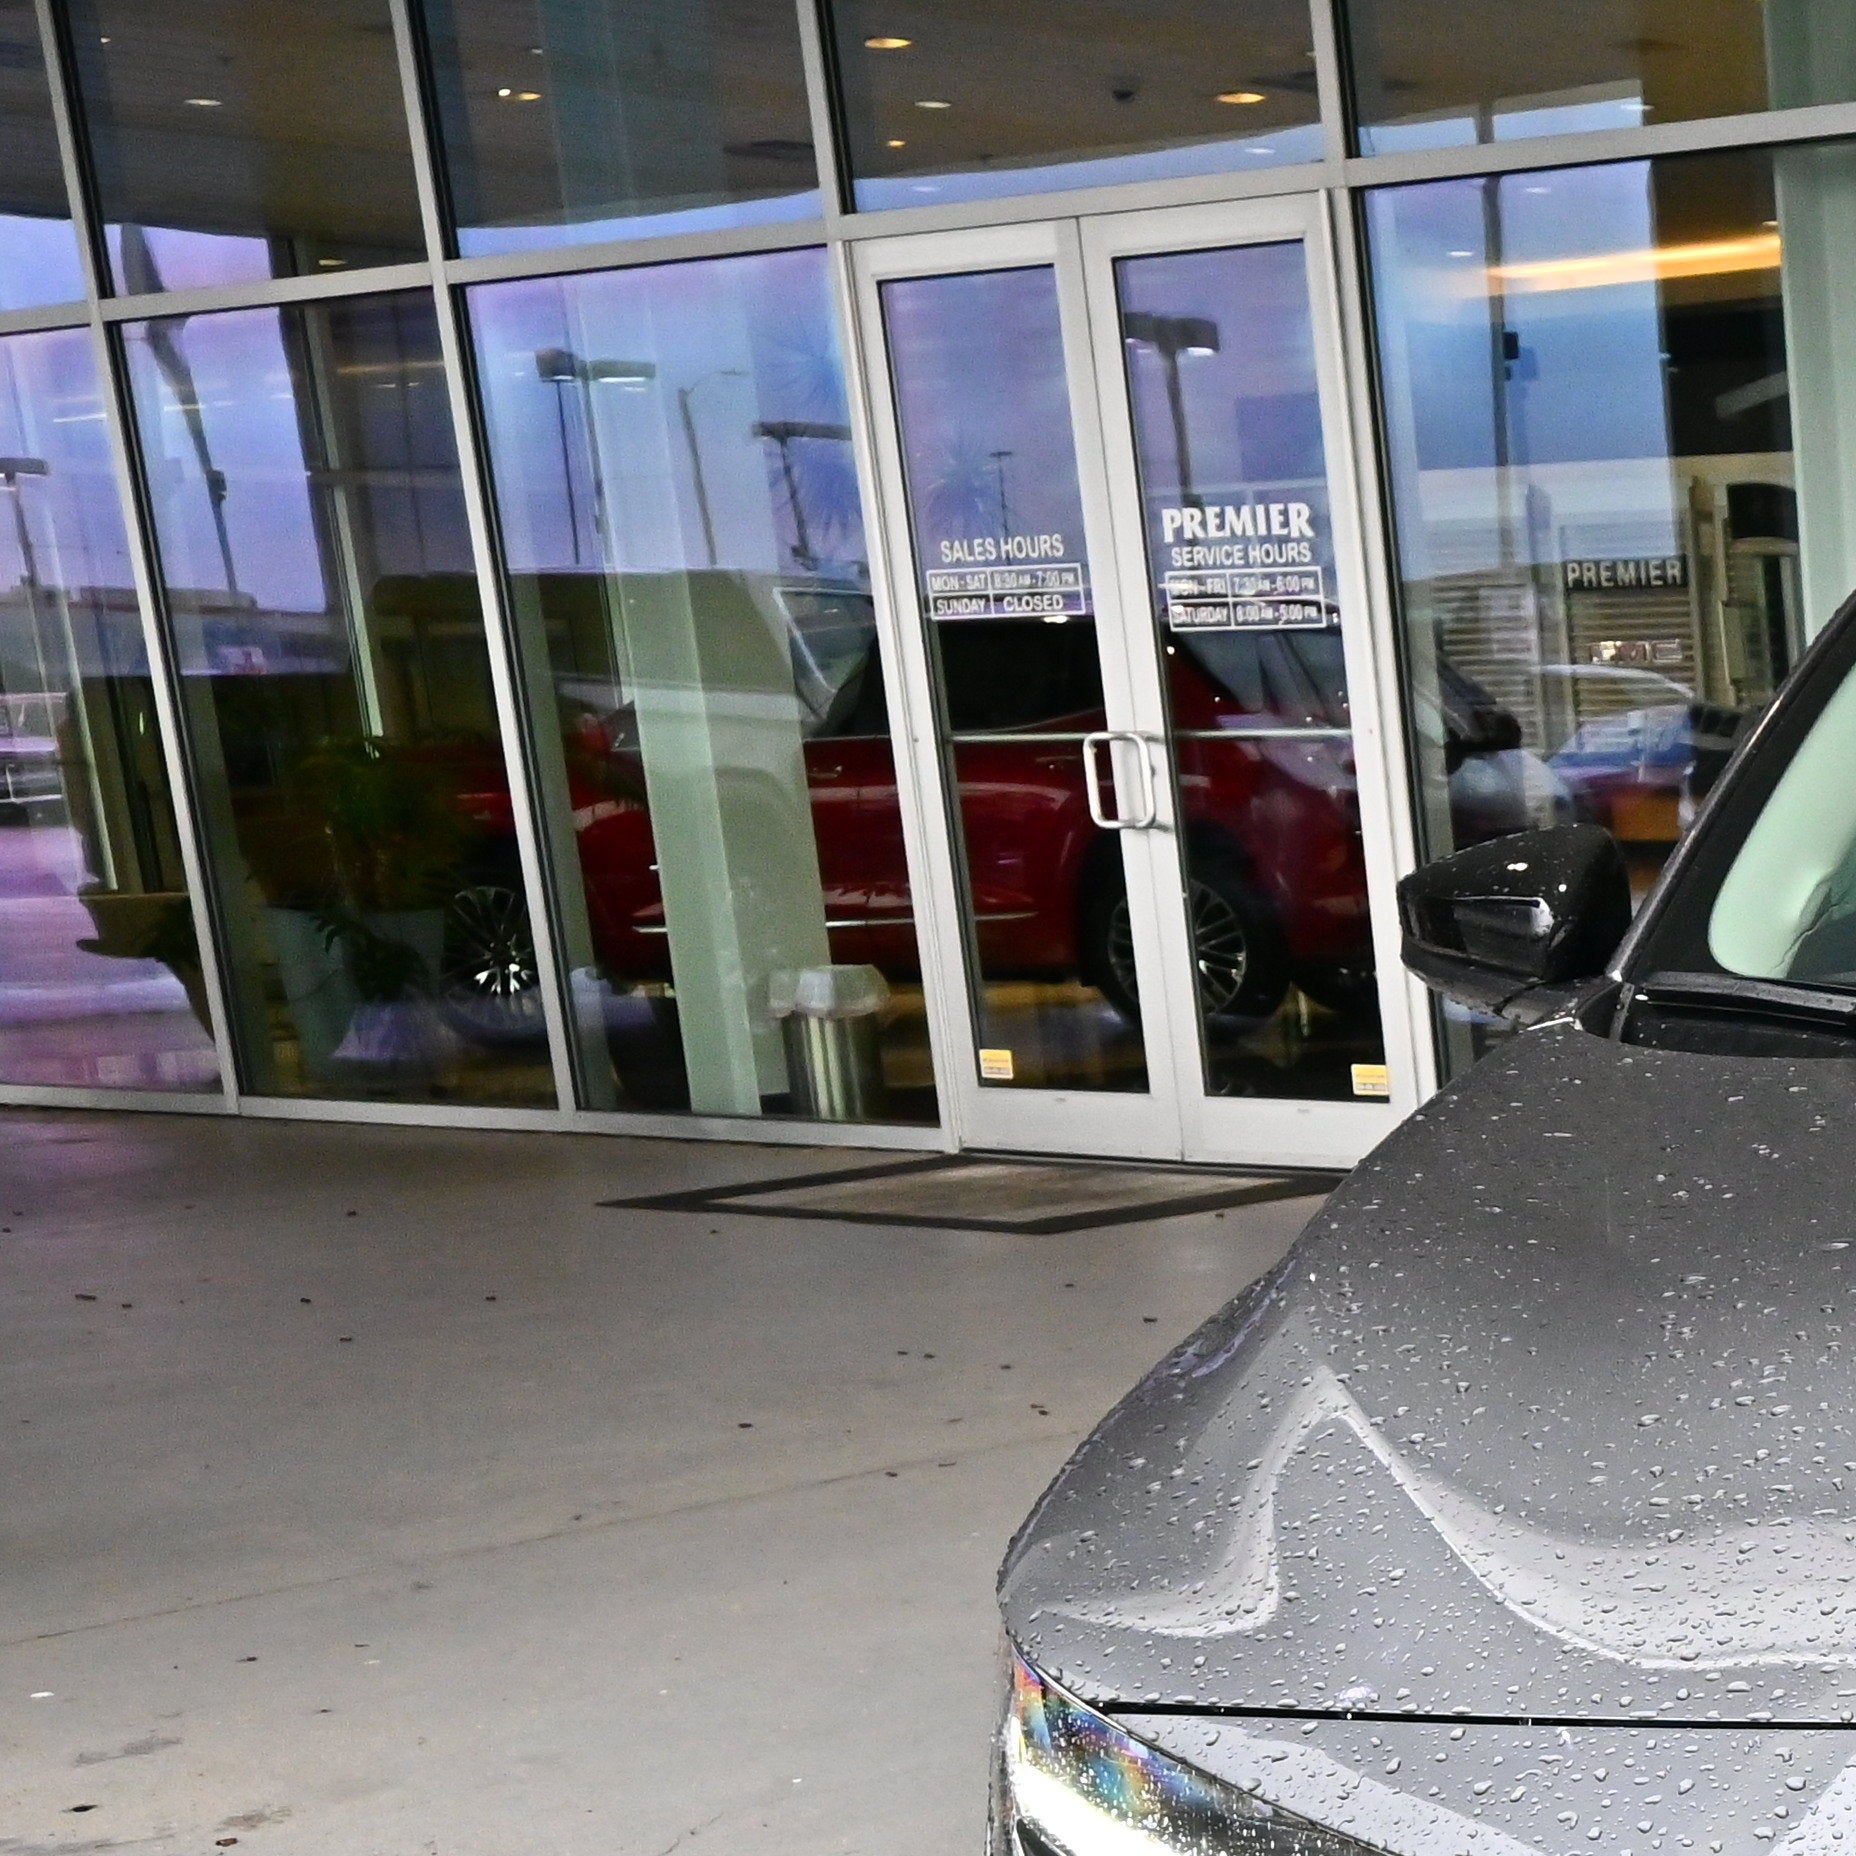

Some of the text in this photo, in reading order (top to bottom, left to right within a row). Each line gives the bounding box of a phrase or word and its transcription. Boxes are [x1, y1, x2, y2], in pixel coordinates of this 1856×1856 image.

[1161, 502, 1315, 544] PREMIER
[940, 533, 1064, 563] SALES HOURS
[1171, 542, 1312, 567] SERVICE HOURS
[1567, 560, 1681, 588] PREMIER
[936, 597, 986, 615] SUNDAY
[1003, 594, 1063, 612] CLOSED
